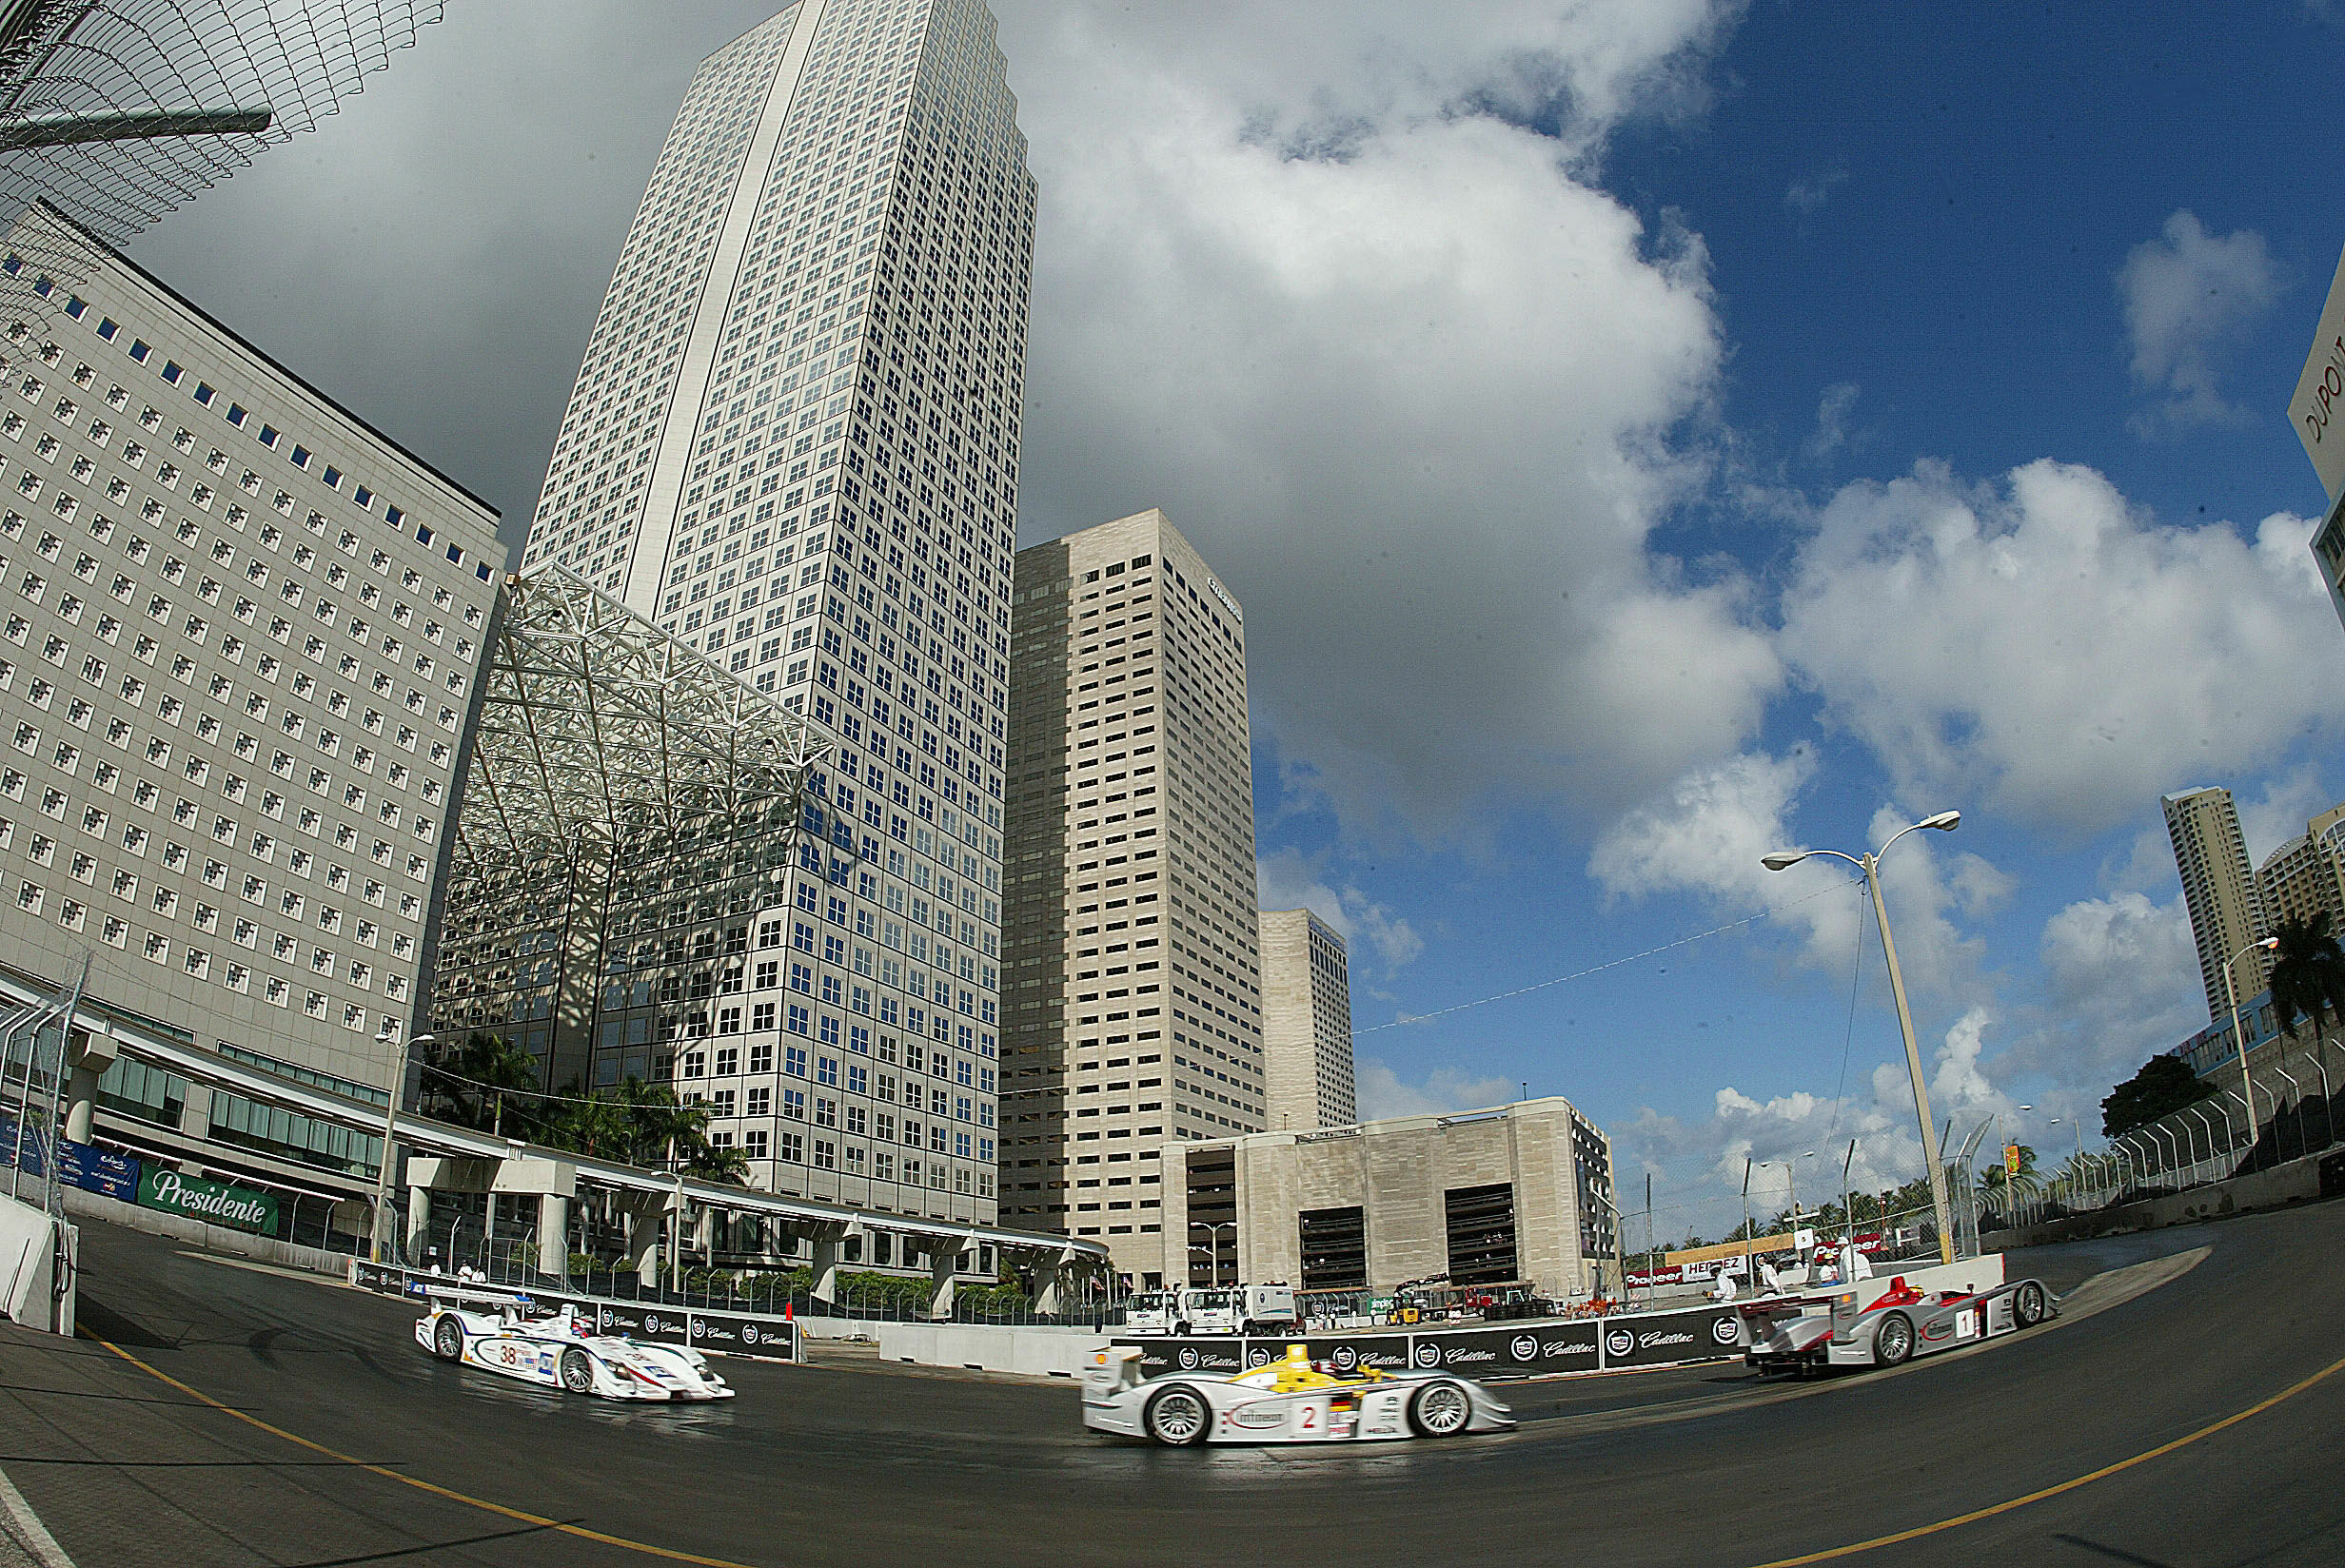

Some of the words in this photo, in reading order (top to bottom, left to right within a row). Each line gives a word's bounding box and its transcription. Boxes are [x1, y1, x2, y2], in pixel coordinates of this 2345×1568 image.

[152, 1170, 266, 1224] Presidente
[1961, 1314, 1968, 1332] 1
[1638, 1330, 1694, 1349] Cadillac
[501, 1344, 517, 1365] 38
[1444, 1347, 1496, 1364] Cadillac
[1542, 1341, 1596, 1358] Cadillac
[1200, 1354, 1240, 1368] Cadillac
[1358, 1352, 1407, 1366] Cadillac
[1302, 1406, 1317, 1429] 2
